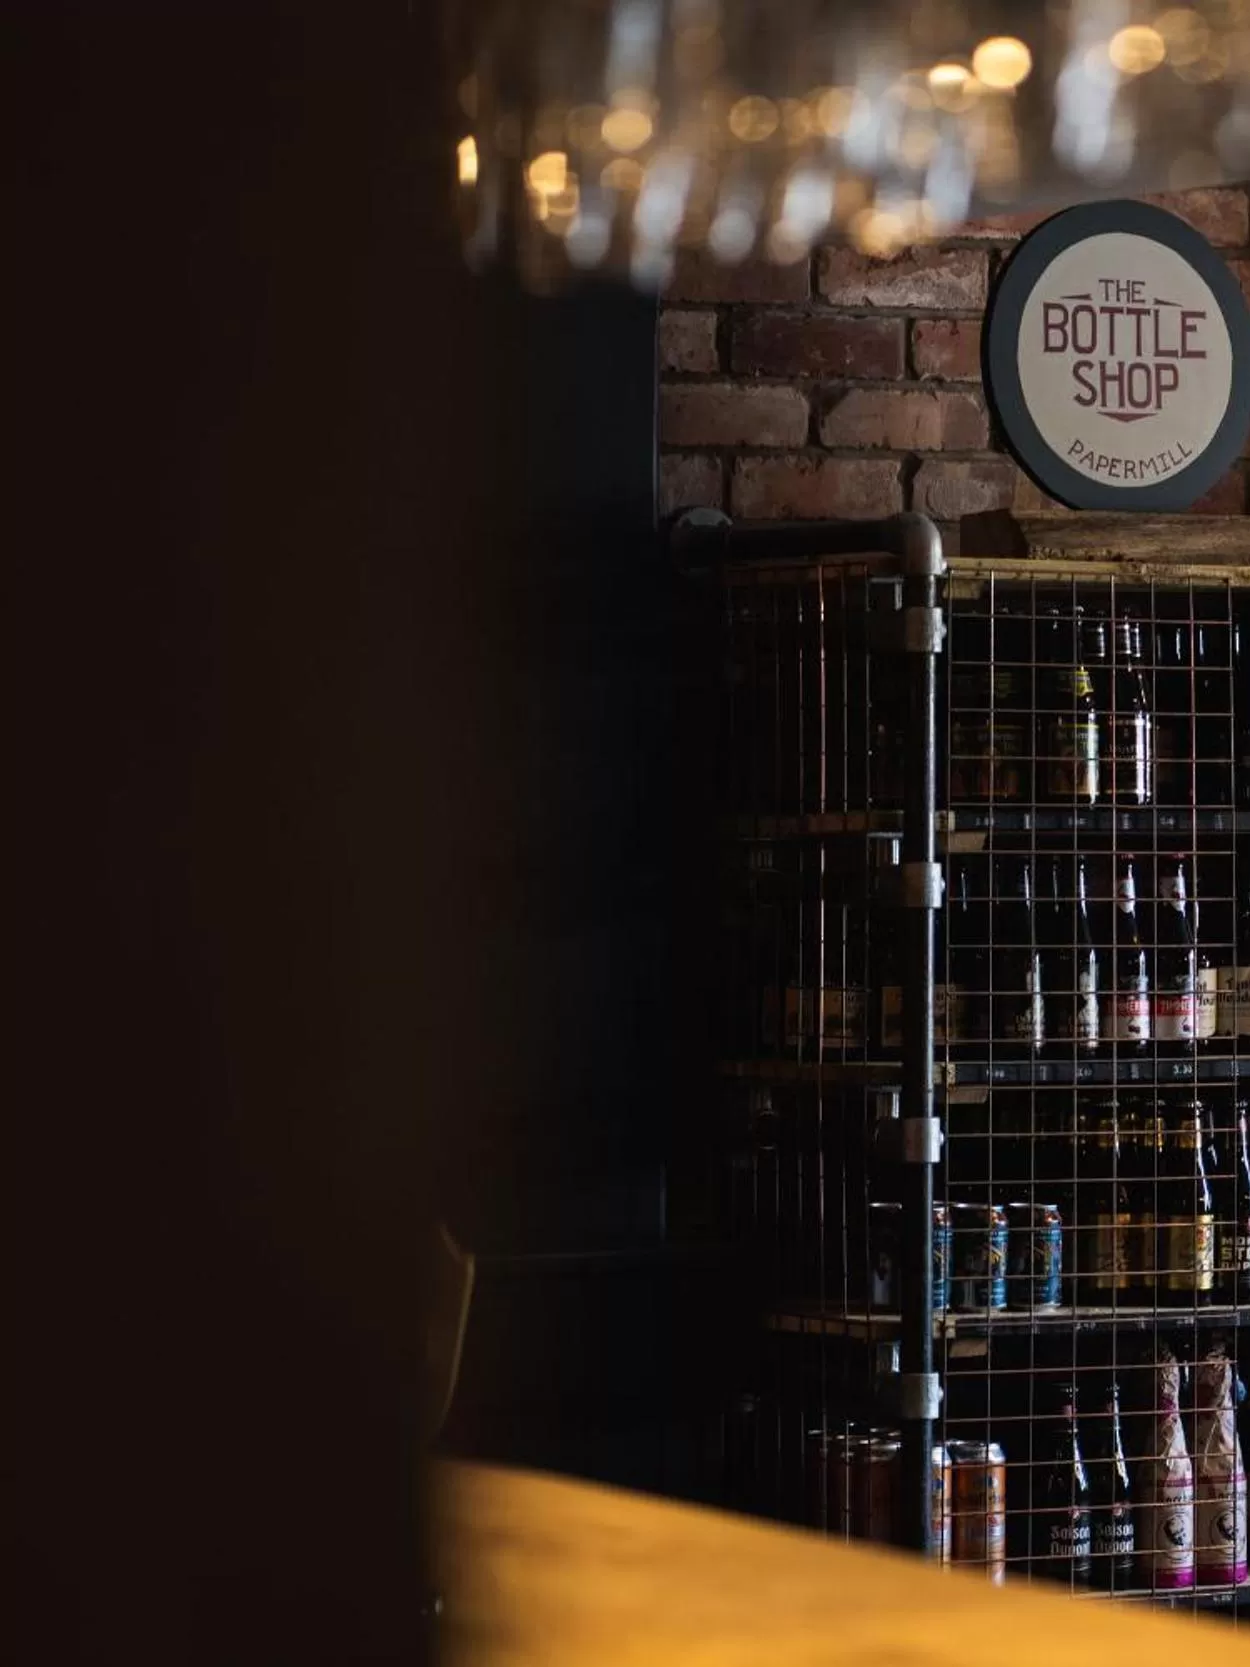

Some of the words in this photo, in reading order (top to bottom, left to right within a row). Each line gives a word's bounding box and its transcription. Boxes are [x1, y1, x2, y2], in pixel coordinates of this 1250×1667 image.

[1099, 279, 1146, 304] THE
[1042, 302, 1207, 359] BOTTLE
[1072, 360, 1179, 409] SHOP
[1067, 439, 1193, 479] PAPERMILL
